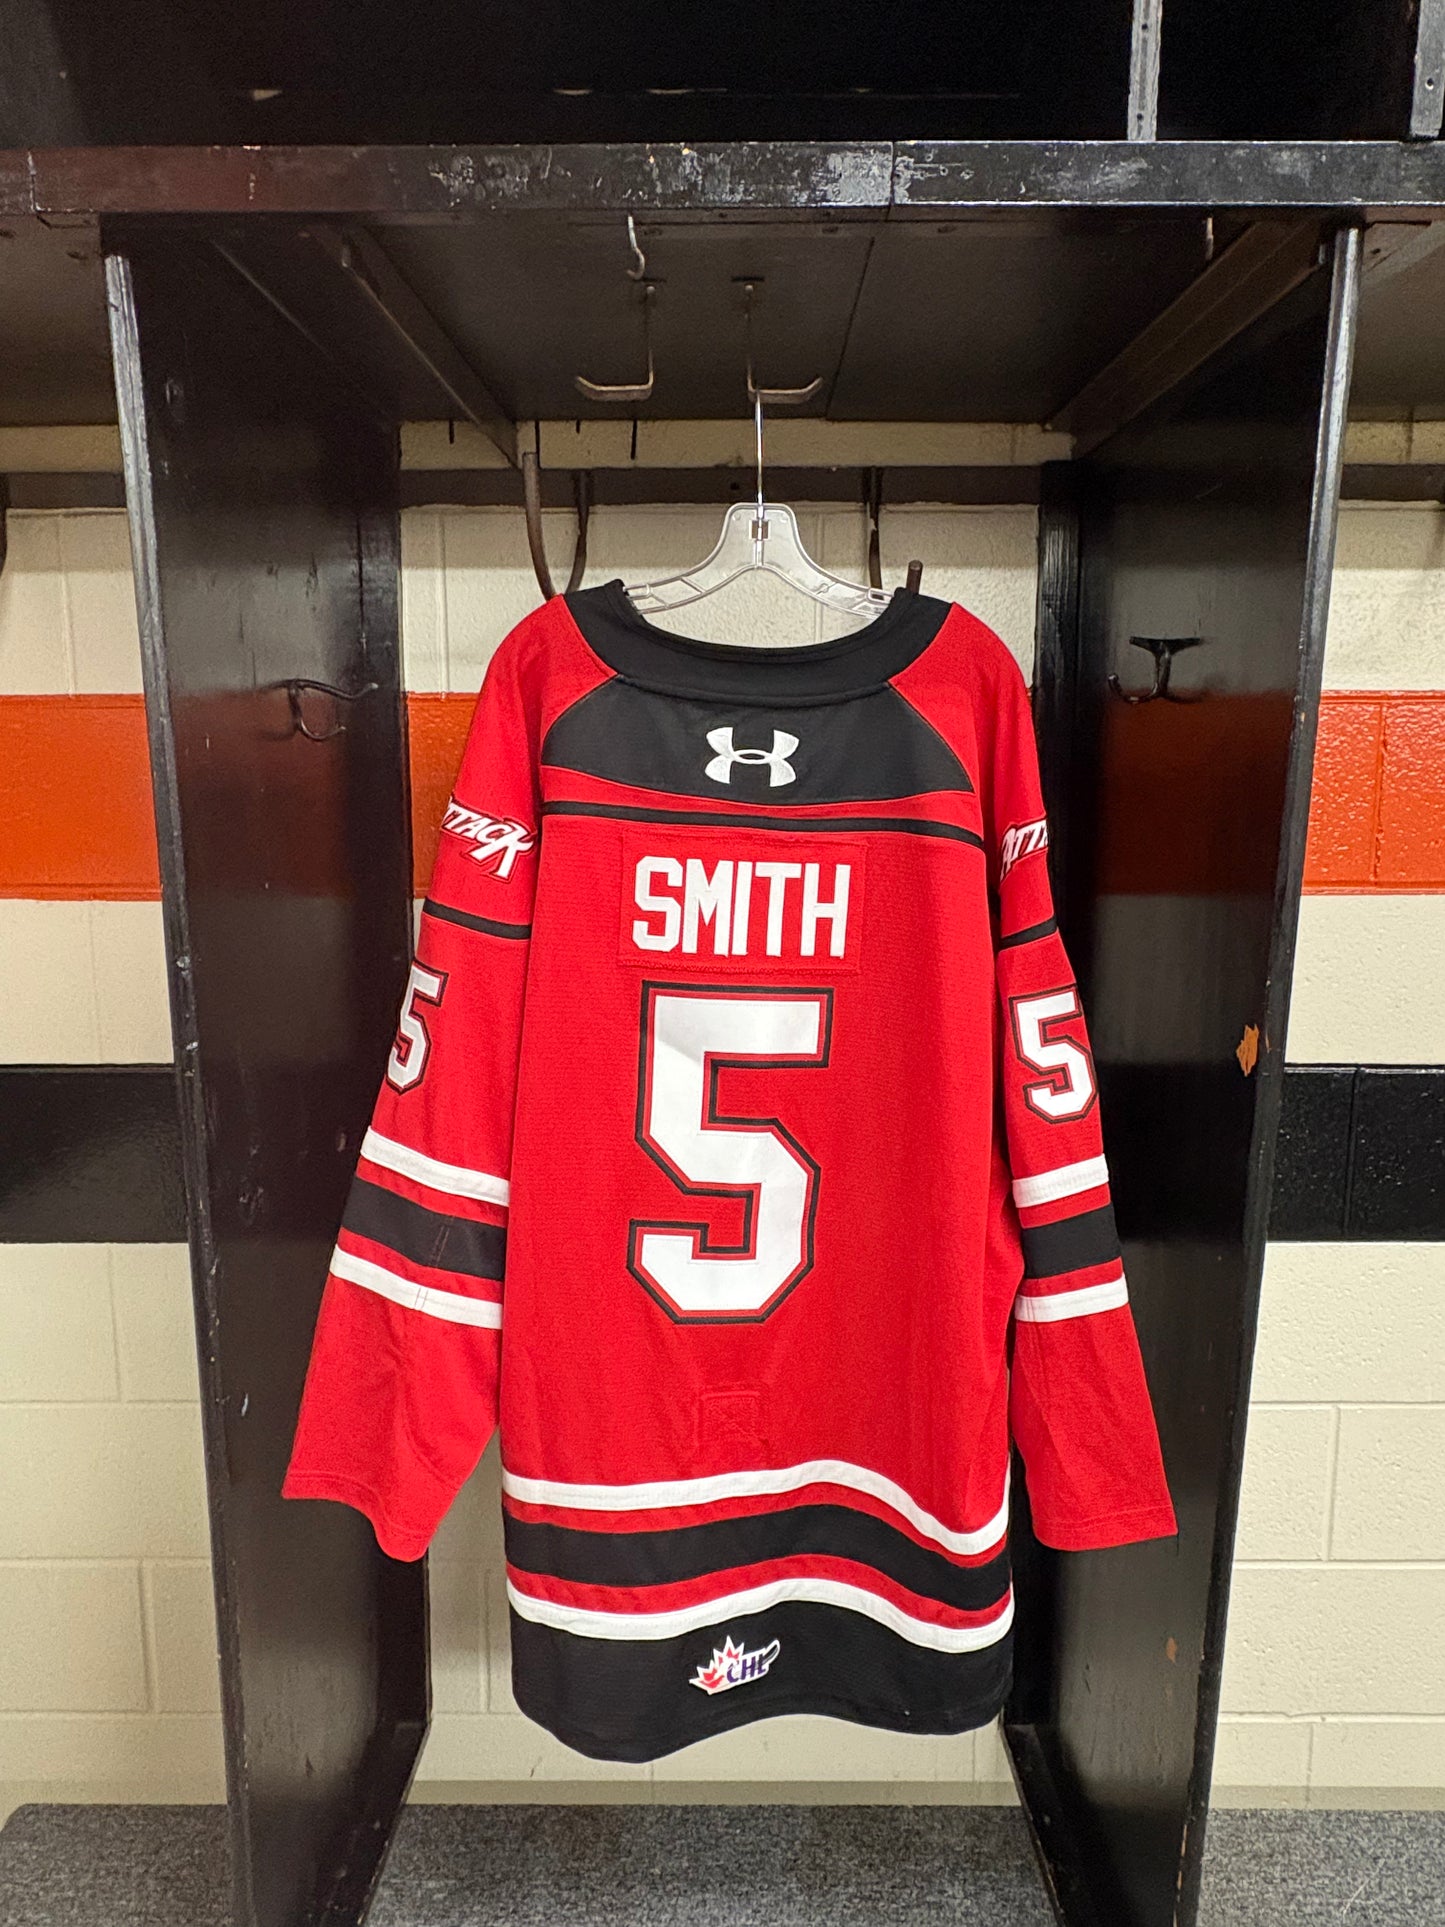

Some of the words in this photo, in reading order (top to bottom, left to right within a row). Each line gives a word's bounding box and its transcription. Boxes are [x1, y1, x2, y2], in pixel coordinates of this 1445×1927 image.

[632, 856, 851, 958] SMITH
[385, 960, 449, 1095] 5
[1008, 983, 1098, 1124] 5
[626, 980, 834, 1324] 5
[727, 1653, 767, 1683] CHL
